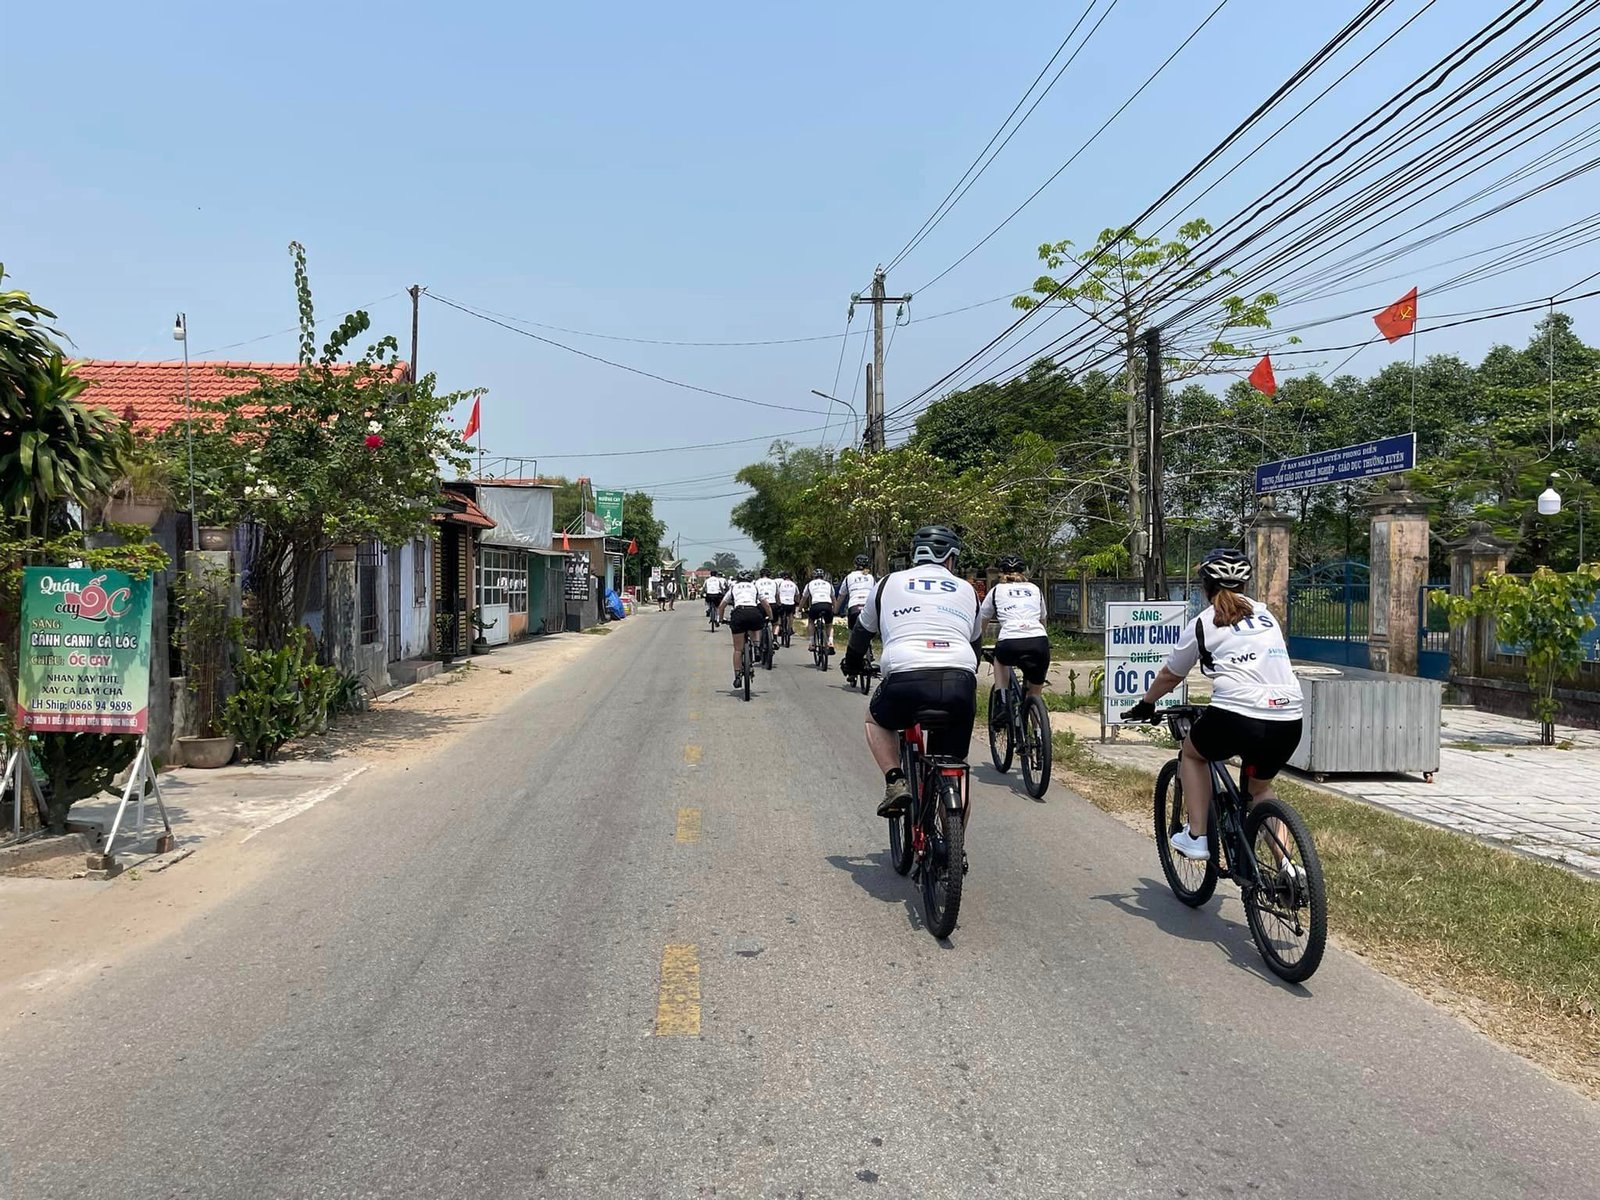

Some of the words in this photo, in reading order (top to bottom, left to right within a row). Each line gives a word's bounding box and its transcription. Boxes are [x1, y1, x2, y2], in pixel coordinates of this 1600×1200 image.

[40, 576, 81, 595] Quán
[908, 578, 958, 593] iTS
[55, 603, 83, 621] cay
[892, 606, 921, 618] twc
[1132, 608, 1163, 621] SÁNG:
[31, 630, 60, 647] BÁNH
[64, 634, 93, 647] CANH
[97, 632, 112, 648] CÁ
[1112, 623, 1145, 644] BÁNH
[1149, 625, 1180, 644] CANH
[68, 651, 86, 667] ỐC
[88, 655, 112, 667] CAY
[1230, 652, 1257, 664] twc
[78, 675, 95, 683] XAY
[1114, 662, 1138, 693] ỐC
[42, 686, 60, 694] XAY
[32, 699, 43, 709] LH
[46, 699, 68, 711] Ship:
[70, 700, 93, 711] 0868
[96, 700, 106, 711] 94
[110, 701, 132, 711] 9898
[1111, 699, 1119, 707] LH
